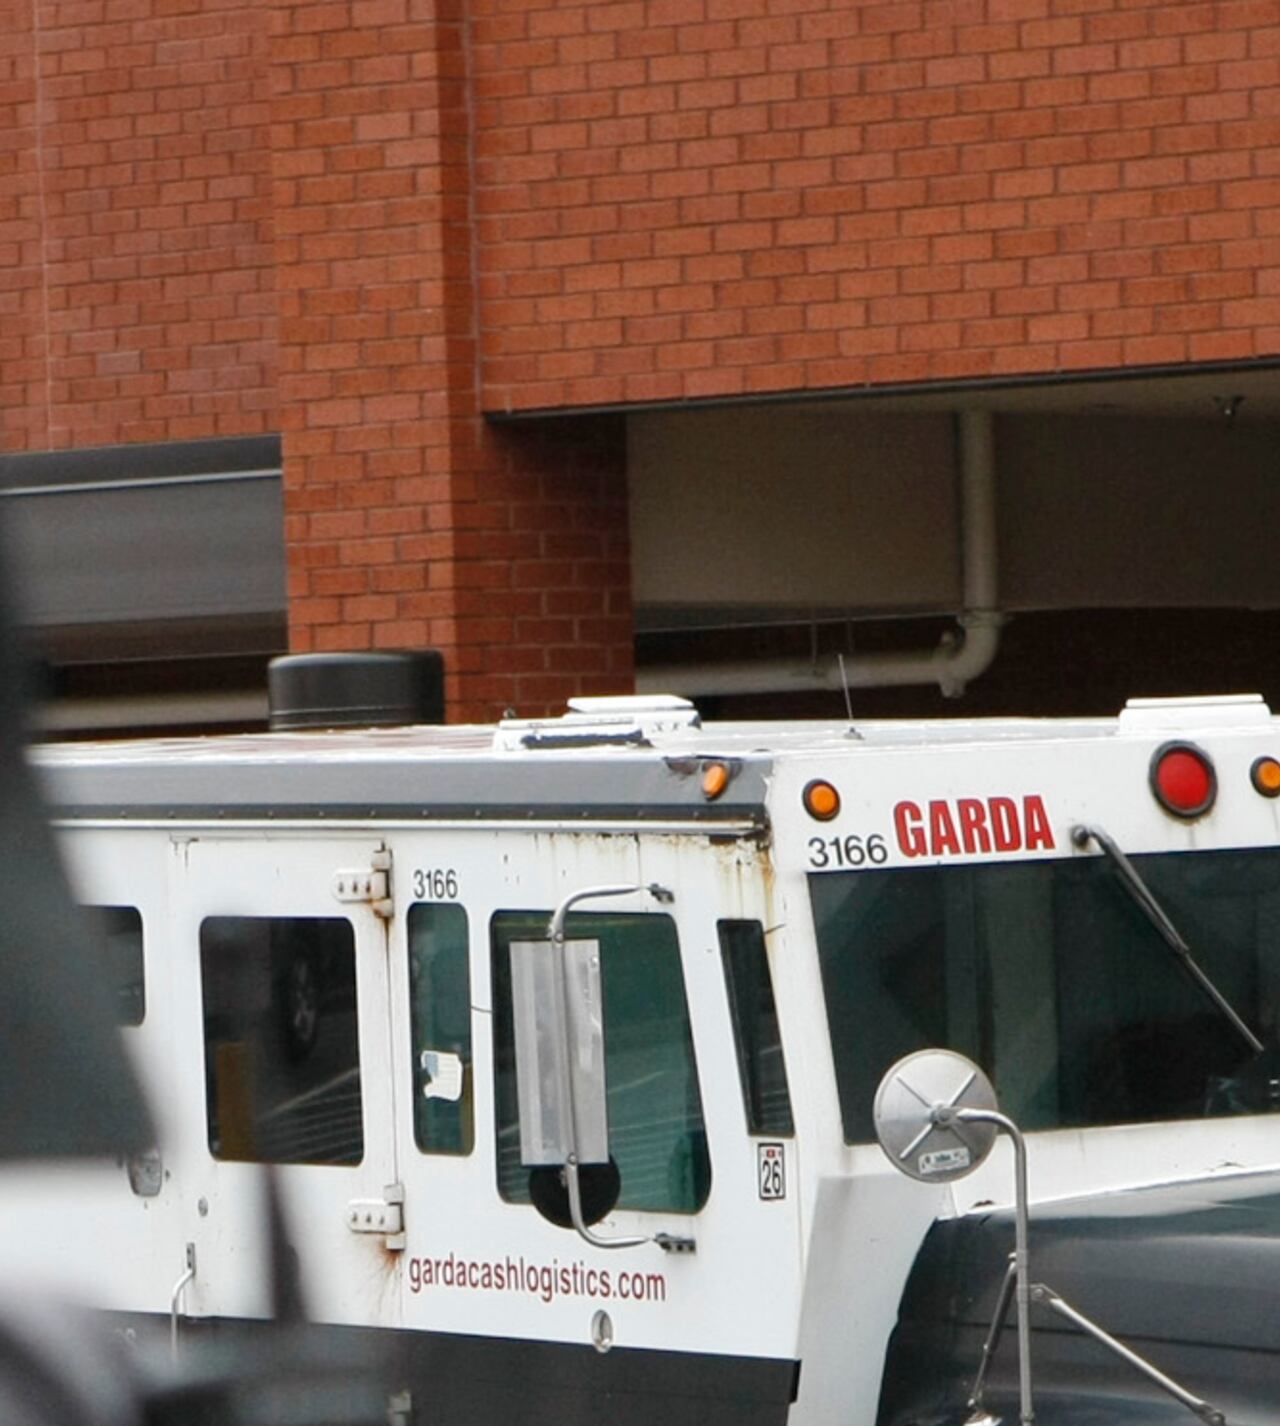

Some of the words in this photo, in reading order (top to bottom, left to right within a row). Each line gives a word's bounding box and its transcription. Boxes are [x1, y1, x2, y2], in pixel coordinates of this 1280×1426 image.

[893, 794, 1056, 858] GARDA
[808, 833, 889, 868] 3166
[413, 869, 458, 899] 3166
[762, 1159, 781, 1194] 26
[409, 1252, 666, 1303] gardacashlogistics.com
